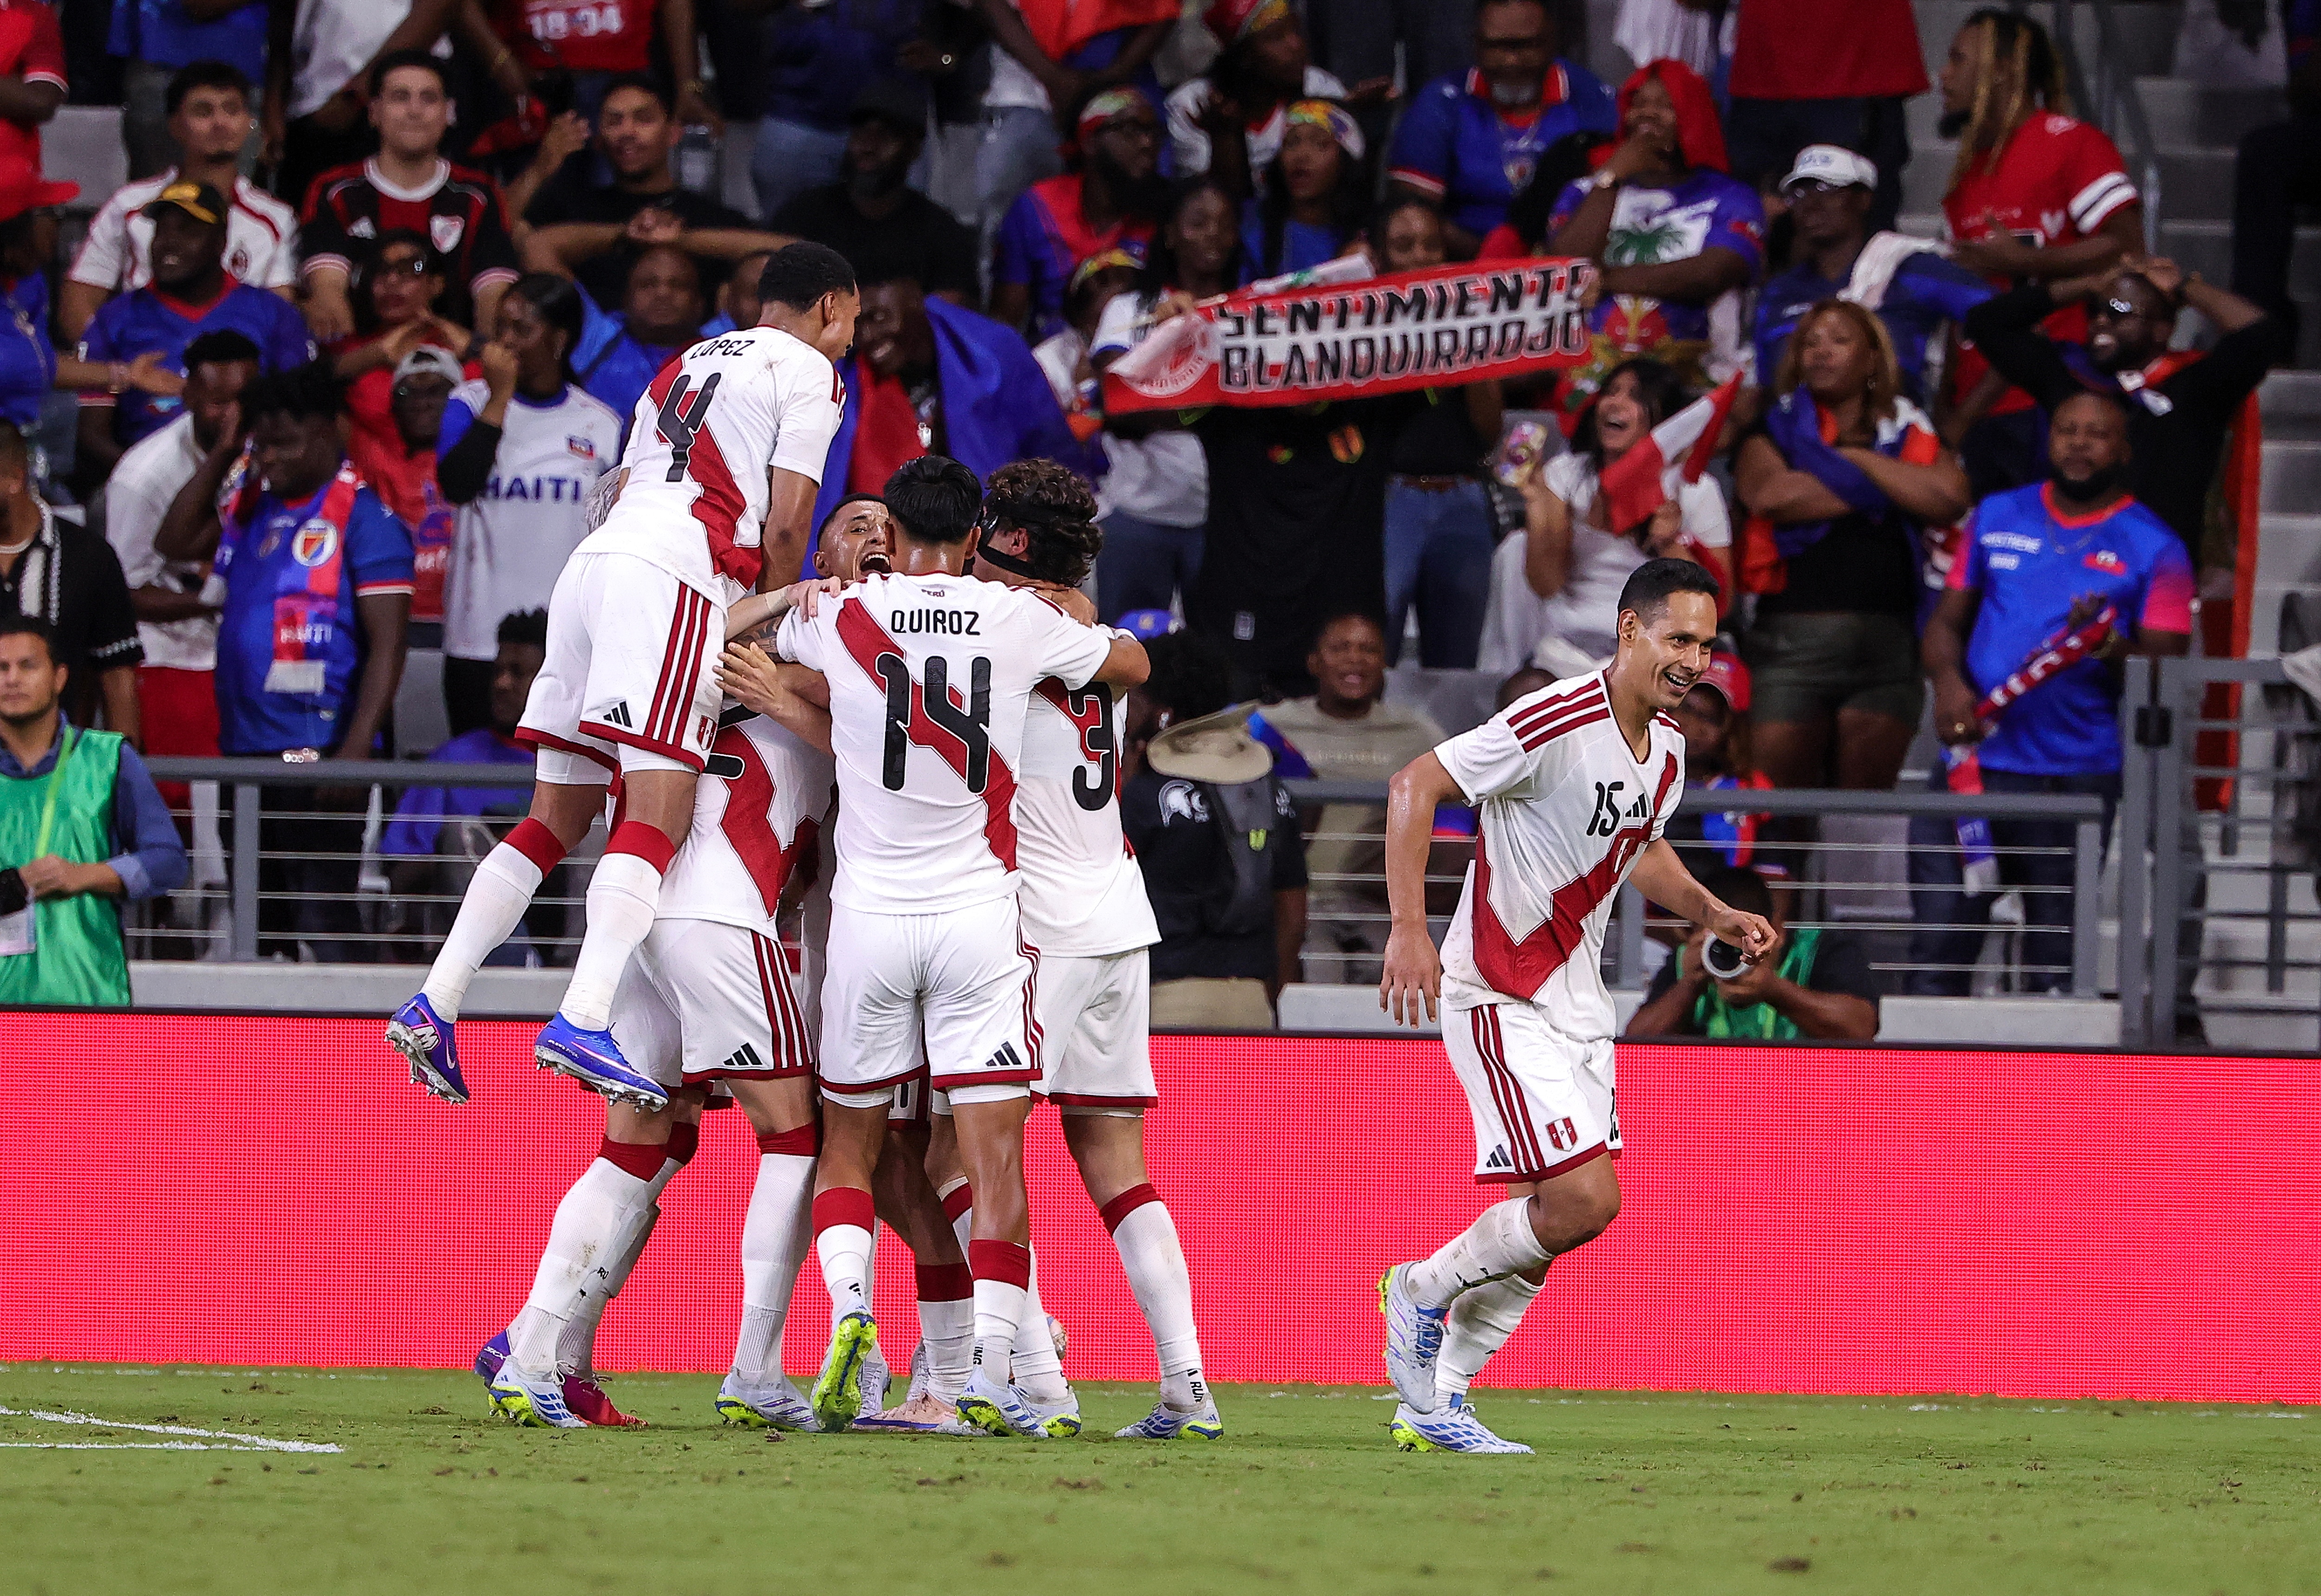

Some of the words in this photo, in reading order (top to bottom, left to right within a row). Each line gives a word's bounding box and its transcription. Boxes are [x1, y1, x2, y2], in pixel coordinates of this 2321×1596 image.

[689, 339, 755, 360] LOPEZ
[658, 372, 721, 482] 4
[891, 609, 980, 636] QUIROZ
[877, 653, 990, 793] 14
[1070, 681, 1113, 811] 3
[1586, 781, 1624, 837] 15
